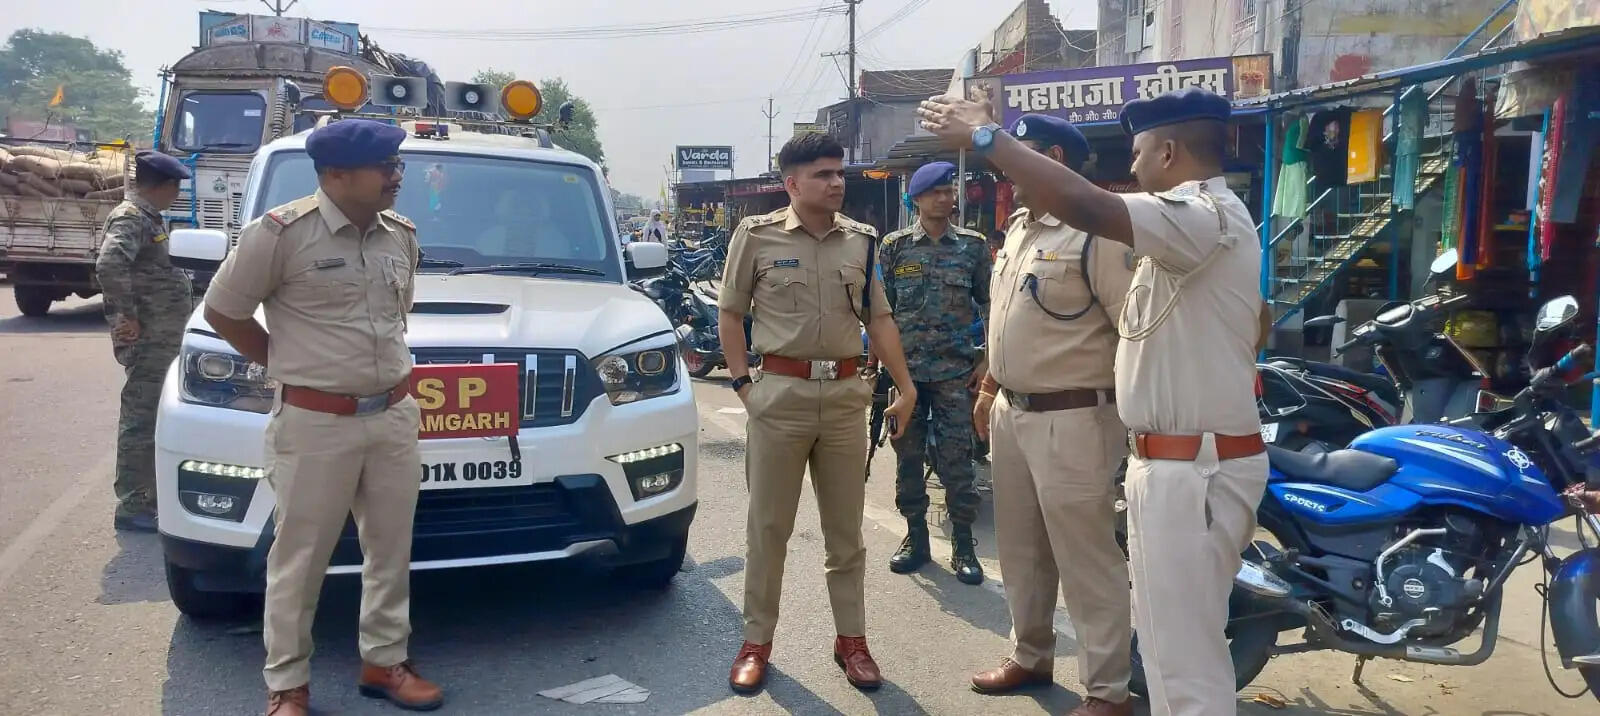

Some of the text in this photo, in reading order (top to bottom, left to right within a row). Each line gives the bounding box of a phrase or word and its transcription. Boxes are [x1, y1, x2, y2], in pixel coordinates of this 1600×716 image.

[1004, 77, 1125, 112] महाराजा
[681, 149, 729, 161] Varda
[462, 460, 522, 480] 0039
[1284, 493, 1325, 512] SPORTS
